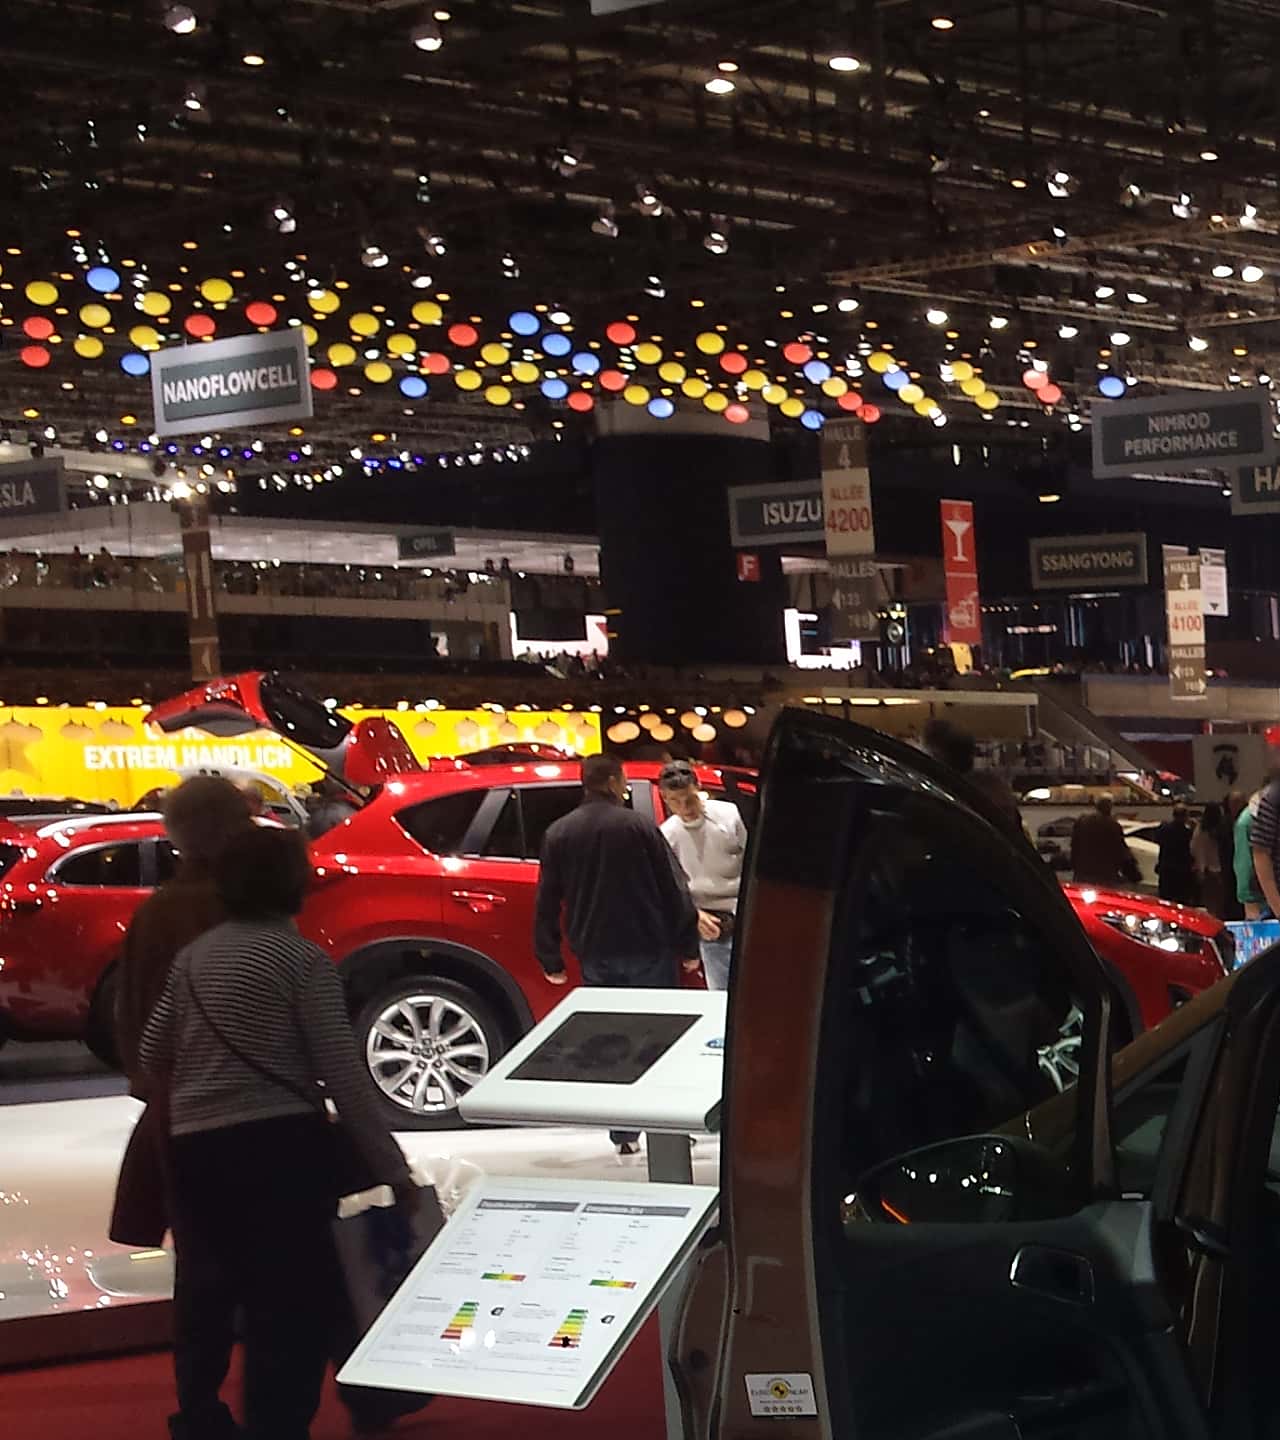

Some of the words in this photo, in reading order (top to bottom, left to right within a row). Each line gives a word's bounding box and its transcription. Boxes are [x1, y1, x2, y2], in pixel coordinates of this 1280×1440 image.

[162, 362, 298, 406] NANOFLOWCELL
[823, 424, 864, 442] HALLE
[1148, 411, 1211, 433] NIMROD
[1123, 431, 1239, 457] PERFORMANCE
[837, 443, 851, 470] 4
[762, 499, 822, 526] ISUZU
[827, 507, 871, 533] 4200
[829, 560, 876, 578] HALLES
[1041, 550, 1135, 571] SSANGYONG
[1170, 561, 1199, 573] HALLE
[1178, 573, 1189, 592] 4
[1171, 615, 1202, 632] 4100
[84, 743, 178, 770] EXTREM
[182, 744, 293, 770] HANDLICH
